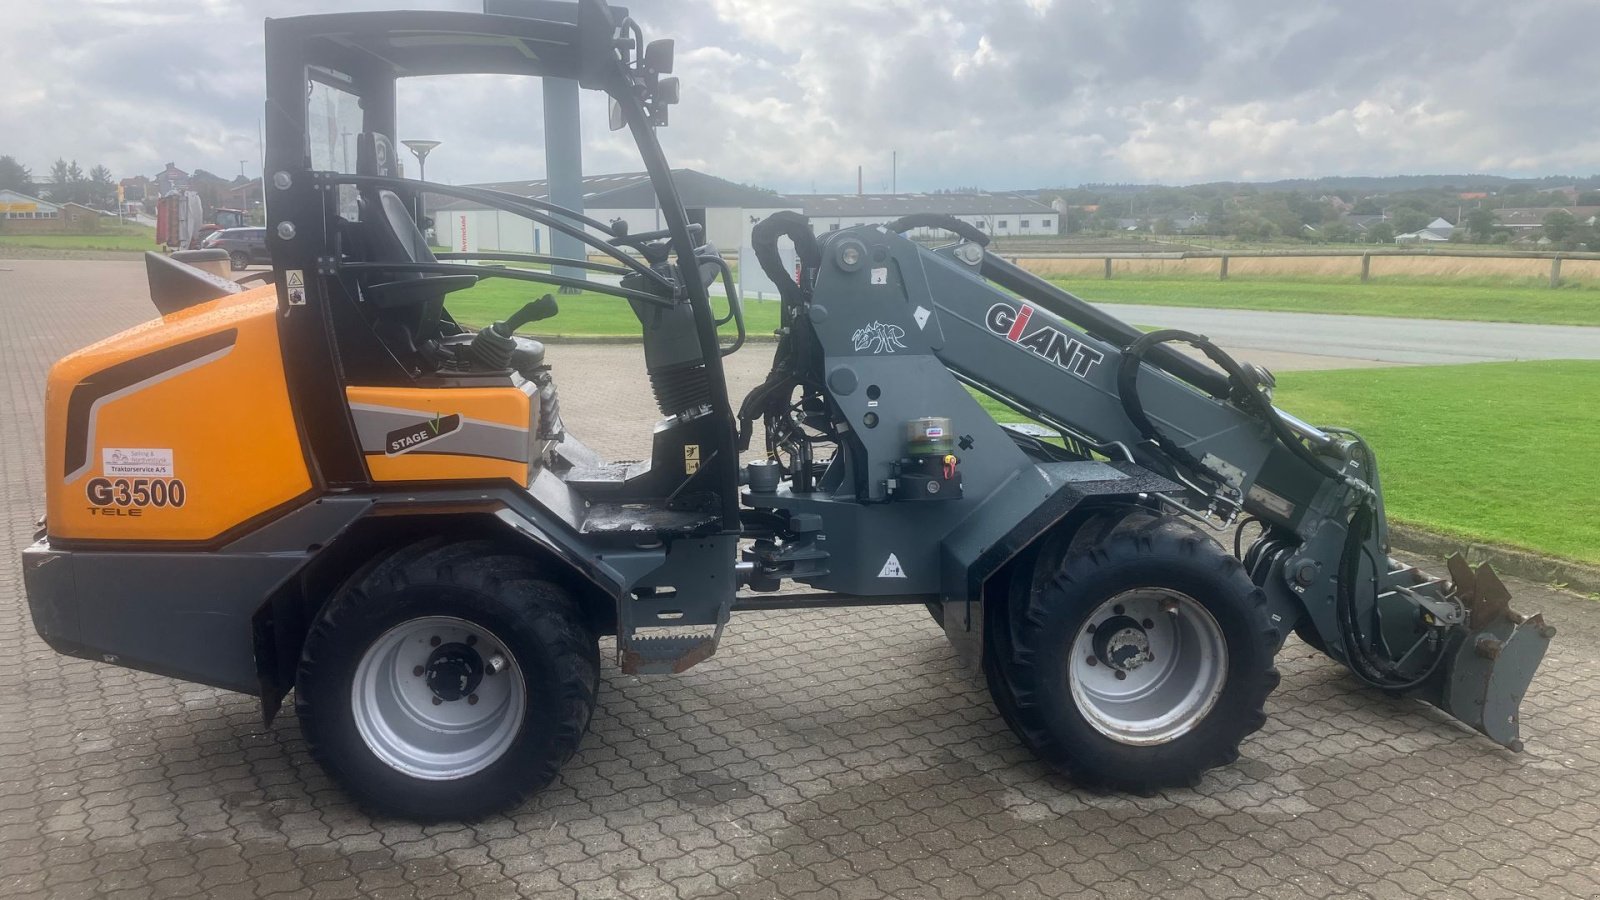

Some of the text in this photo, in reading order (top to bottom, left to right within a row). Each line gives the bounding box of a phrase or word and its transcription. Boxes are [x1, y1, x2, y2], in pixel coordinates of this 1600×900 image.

[391, 430, 429, 450] STAGE
[86, 477, 186, 507] G3500
[87, 507, 142, 517] TELE
